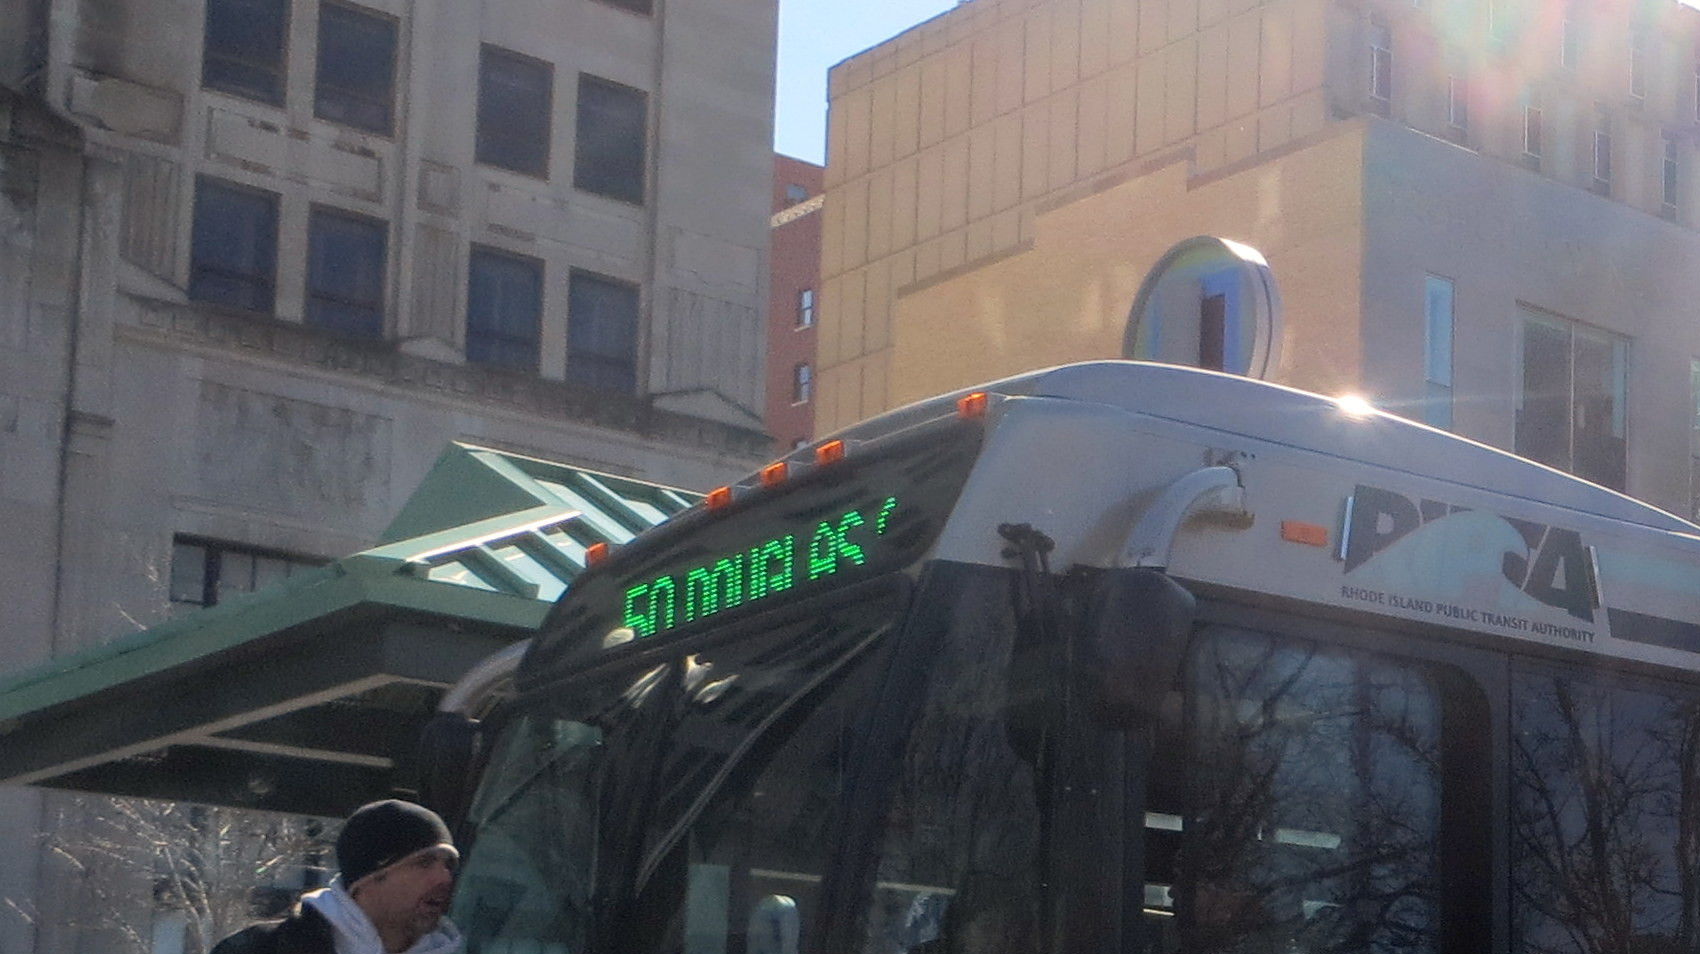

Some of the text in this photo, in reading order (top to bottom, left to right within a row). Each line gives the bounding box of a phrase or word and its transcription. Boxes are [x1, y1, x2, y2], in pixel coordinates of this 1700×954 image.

[1341, 586, 1596, 644] RHODE ISLAND PUBLIC TRANSIT AUTHORITY
